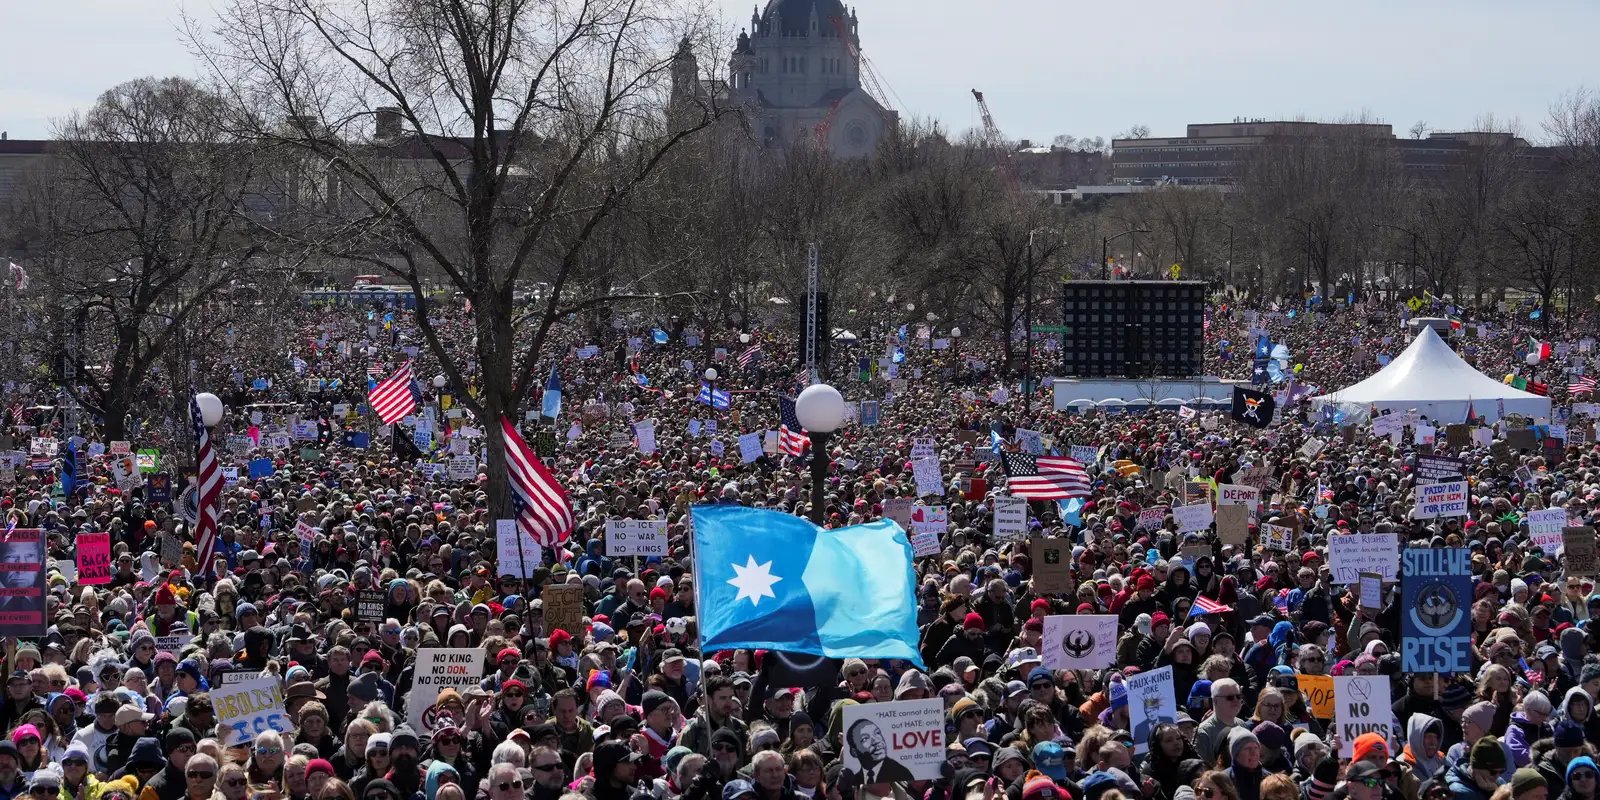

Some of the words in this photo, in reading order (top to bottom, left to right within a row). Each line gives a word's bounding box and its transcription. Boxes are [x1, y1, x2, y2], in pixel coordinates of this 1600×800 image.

[1224, 490, 1257, 500] DEPORT
[1424, 485, 1447, 495] PAID?
[1448, 484, 1460, 493] NO
[1428, 495, 1445, 503] HATE
[1447, 493, 1461, 501] HIM
[1424, 504, 1439, 513] FOR
[1441, 502, 1464, 512] FREE!
[1141, 510, 1164, 520] PEOPLE
[1530, 514, 1541, 522] NO
[1543, 512, 1565, 521] KINGS
[1531, 524, 1543, 533] NO
[1332, 536, 1358, 546] EQUAL
[1362, 535, 1389, 544] RIGHTS
[1533, 535, 1546, 545] NO
[1548, 534, 1563, 543] WA
[636, 545, 662, 553] KINGS
[81, 554, 108, 567] BACK
[1402, 548, 1446, 577] STILL
[1447, 548, 1471, 576] WE
[80, 566, 110, 579] AGAIN
[358, 602, 366, 610] NO
[367, 602, 384, 610] KINGS
[545, 608, 581, 622] OUT
[433, 654, 447, 662] NO
[448, 654, 473, 662] KING.
[1402, 636, 1471, 673] RISE
[432, 666, 445, 674] NO
[447, 666, 468, 674] DON.
[418, 676, 433, 684] NO
[433, 676, 480, 685] CROWNED
[1129, 671, 1171, 691] FAUX-KING
[1142, 684, 1159, 695] JOKE
[216, 684, 284, 721] ABOLISH
[899, 709, 922, 717] cannot
[924, 707, 940, 715] drive
[1349, 703, 1370, 717] NO
[232, 714, 283, 741] ICE
[926, 718, 941, 727] only
[893, 730, 942, 750] LOVE
